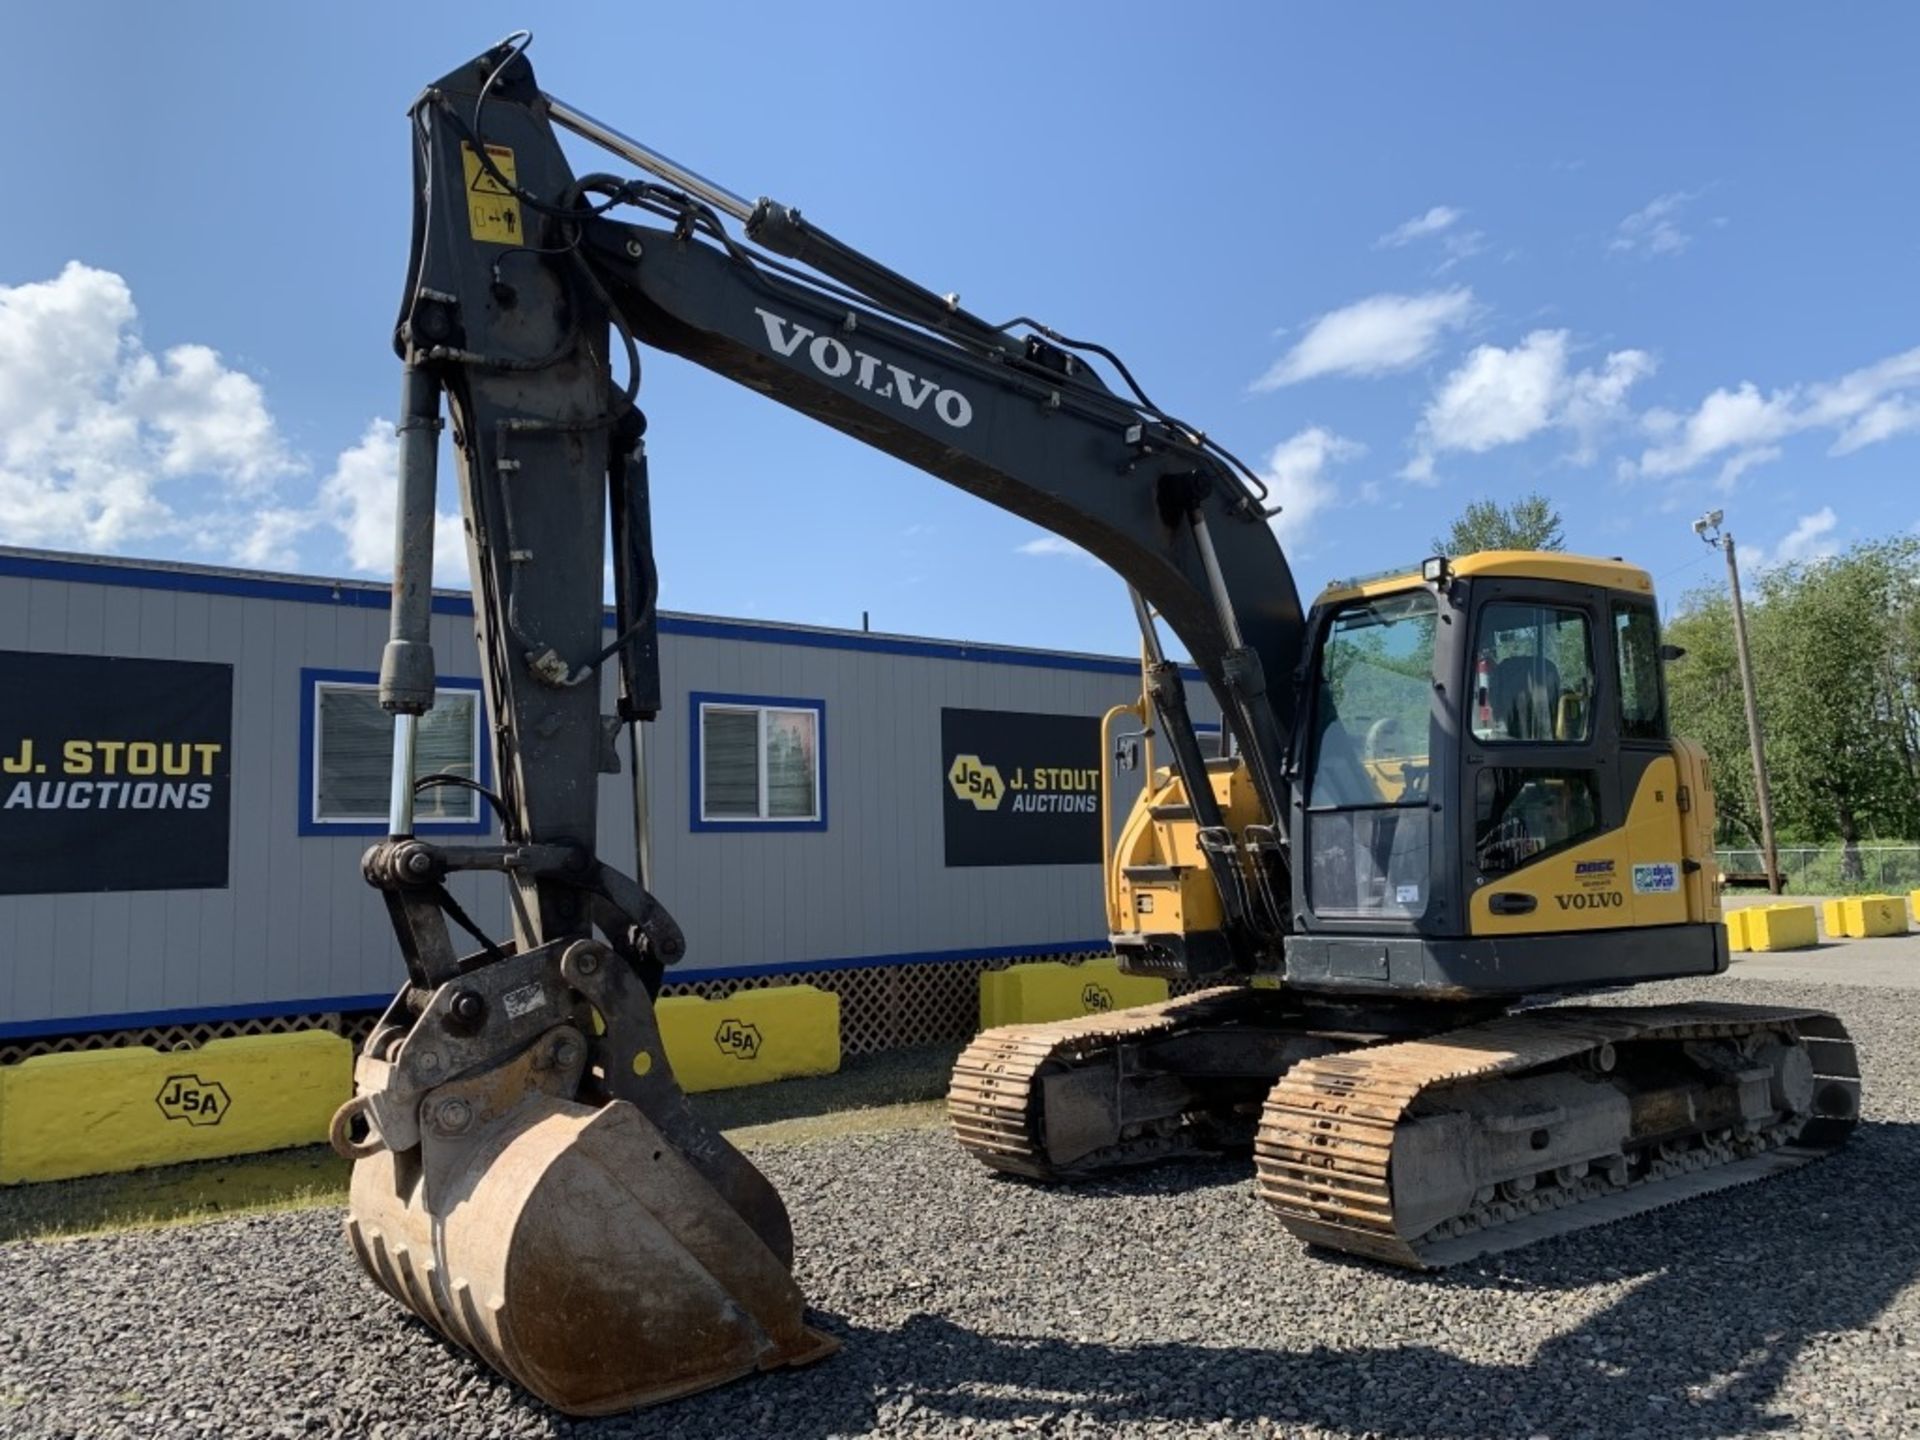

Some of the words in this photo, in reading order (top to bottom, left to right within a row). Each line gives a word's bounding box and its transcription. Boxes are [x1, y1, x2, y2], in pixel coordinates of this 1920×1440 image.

[755, 307, 972, 428] VOLVO
[3, 739, 46, 774] J.
[63, 740, 222, 776] STOUT
[955, 762, 996, 799] JSA
[1010, 767, 1028, 790] J.
[1034, 768, 1099, 791] STOUT
[3, 781, 212, 809] AUCTIONS
[1012, 794, 1098, 813] AUCTIONS
[1554, 891, 1623, 910] VOLVO
[1085, 988, 1109, 1010] JSA
[720, 1025, 754, 1051] JSA
[164, 1083, 218, 1115] JSA
